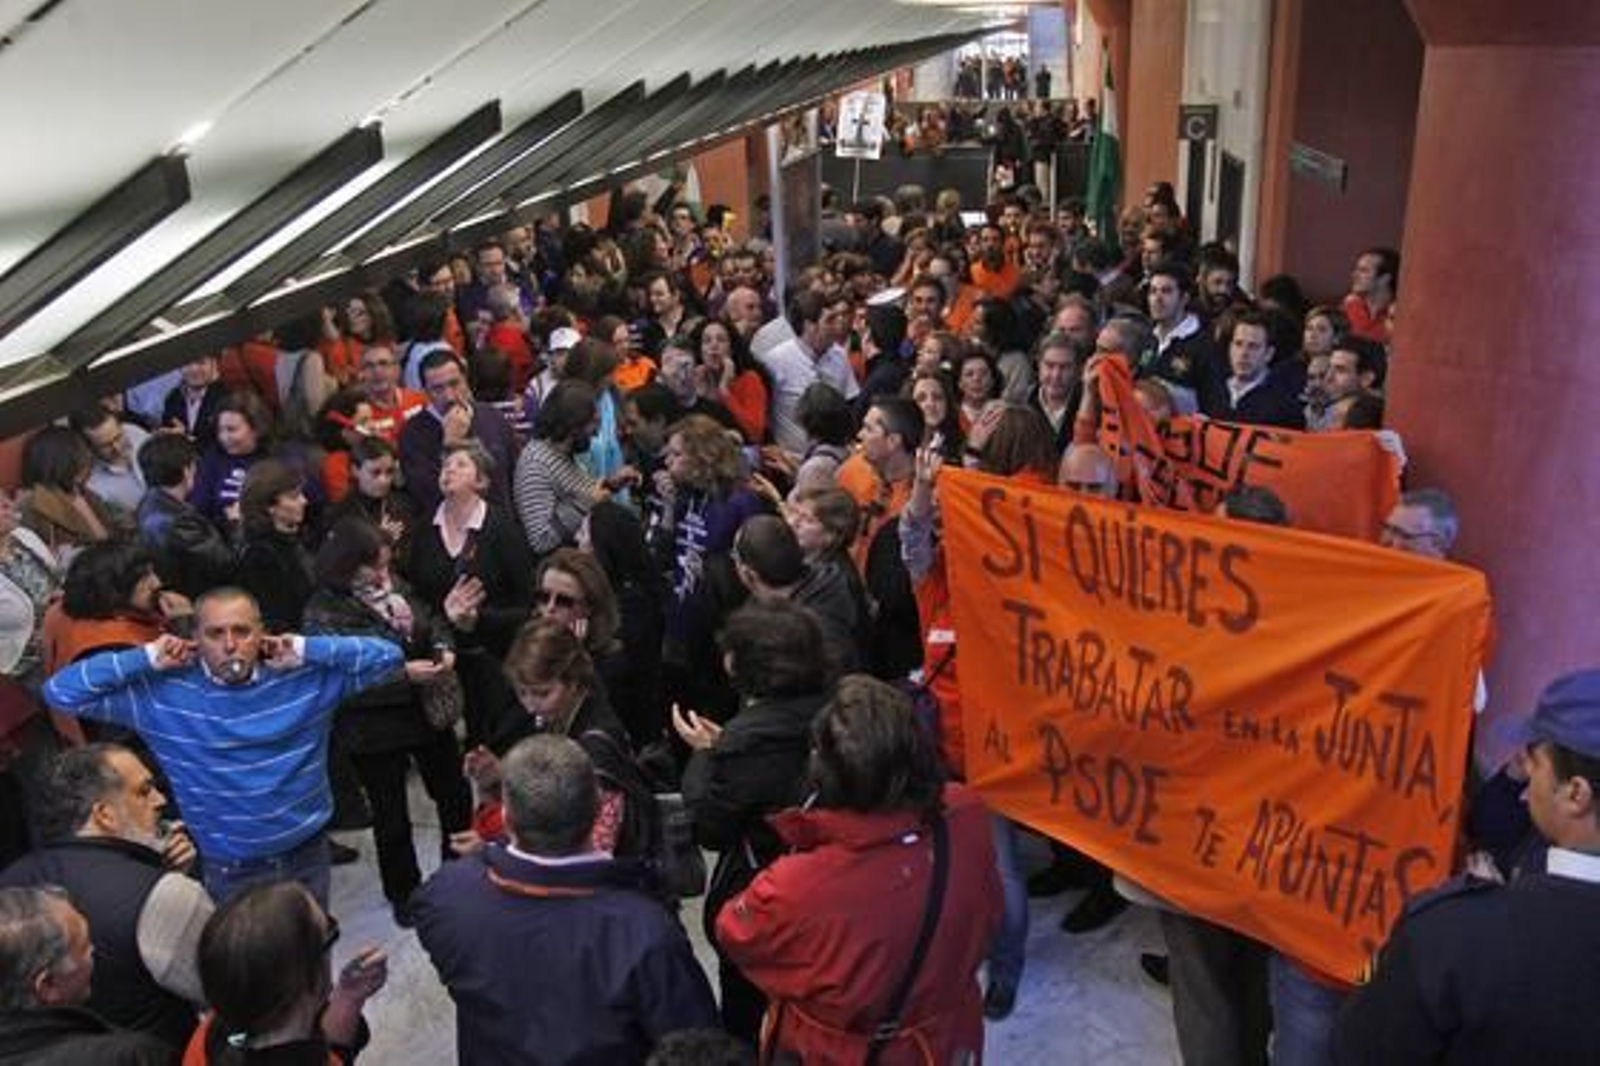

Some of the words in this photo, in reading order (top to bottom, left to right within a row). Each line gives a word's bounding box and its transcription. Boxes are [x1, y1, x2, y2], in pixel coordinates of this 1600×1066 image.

[1003, 600, 1197, 732] TRABAJAR
[1223, 710, 1260, 741] EN
[983, 718, 1011, 764] AL
[1037, 722, 1169, 847] PSOE
[1193, 807, 1231, 869] TE
